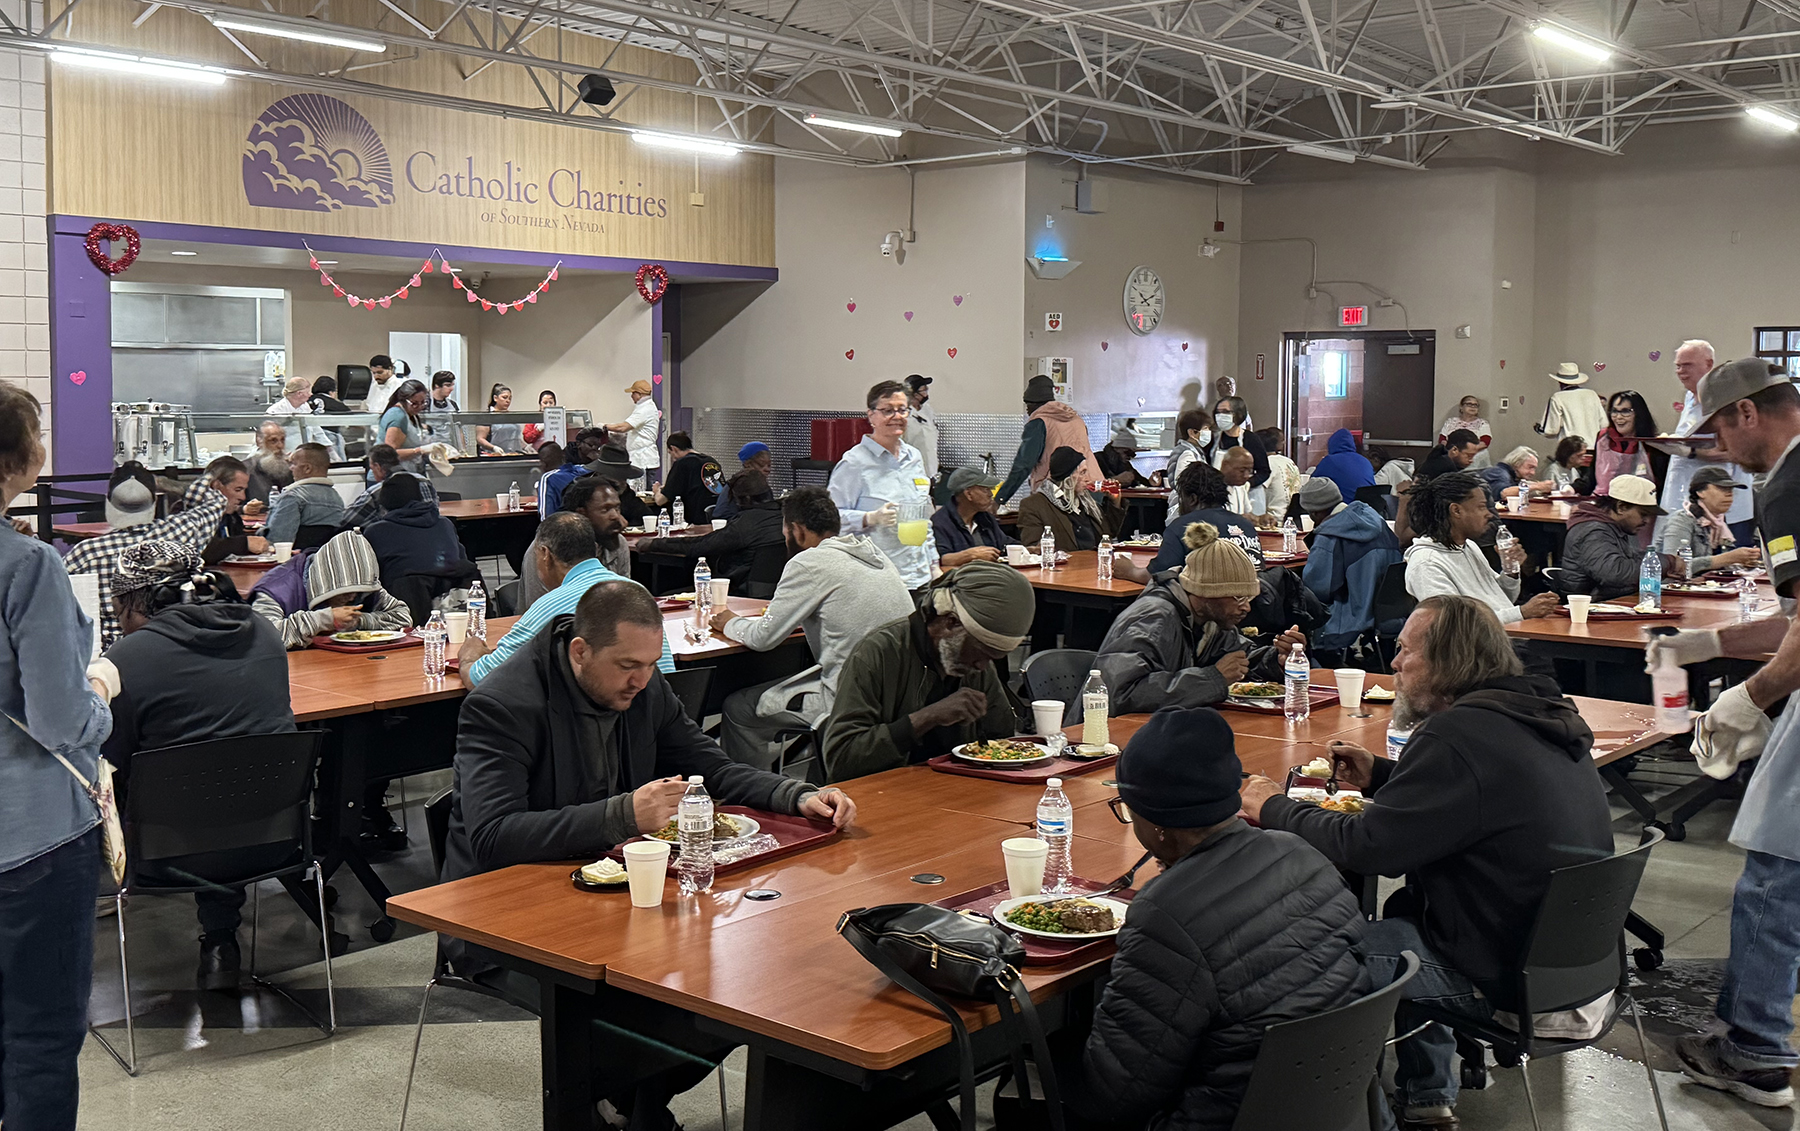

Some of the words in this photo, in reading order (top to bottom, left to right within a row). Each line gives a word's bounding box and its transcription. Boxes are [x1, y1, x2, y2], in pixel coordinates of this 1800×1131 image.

[405, 150, 539, 204] Catholic
[547, 168, 667, 218] Charities
[499, 207, 559, 229] SOUTHERN
[561, 213, 605, 233] NEVADA
[1342, 307, 1364, 325] EXIT
